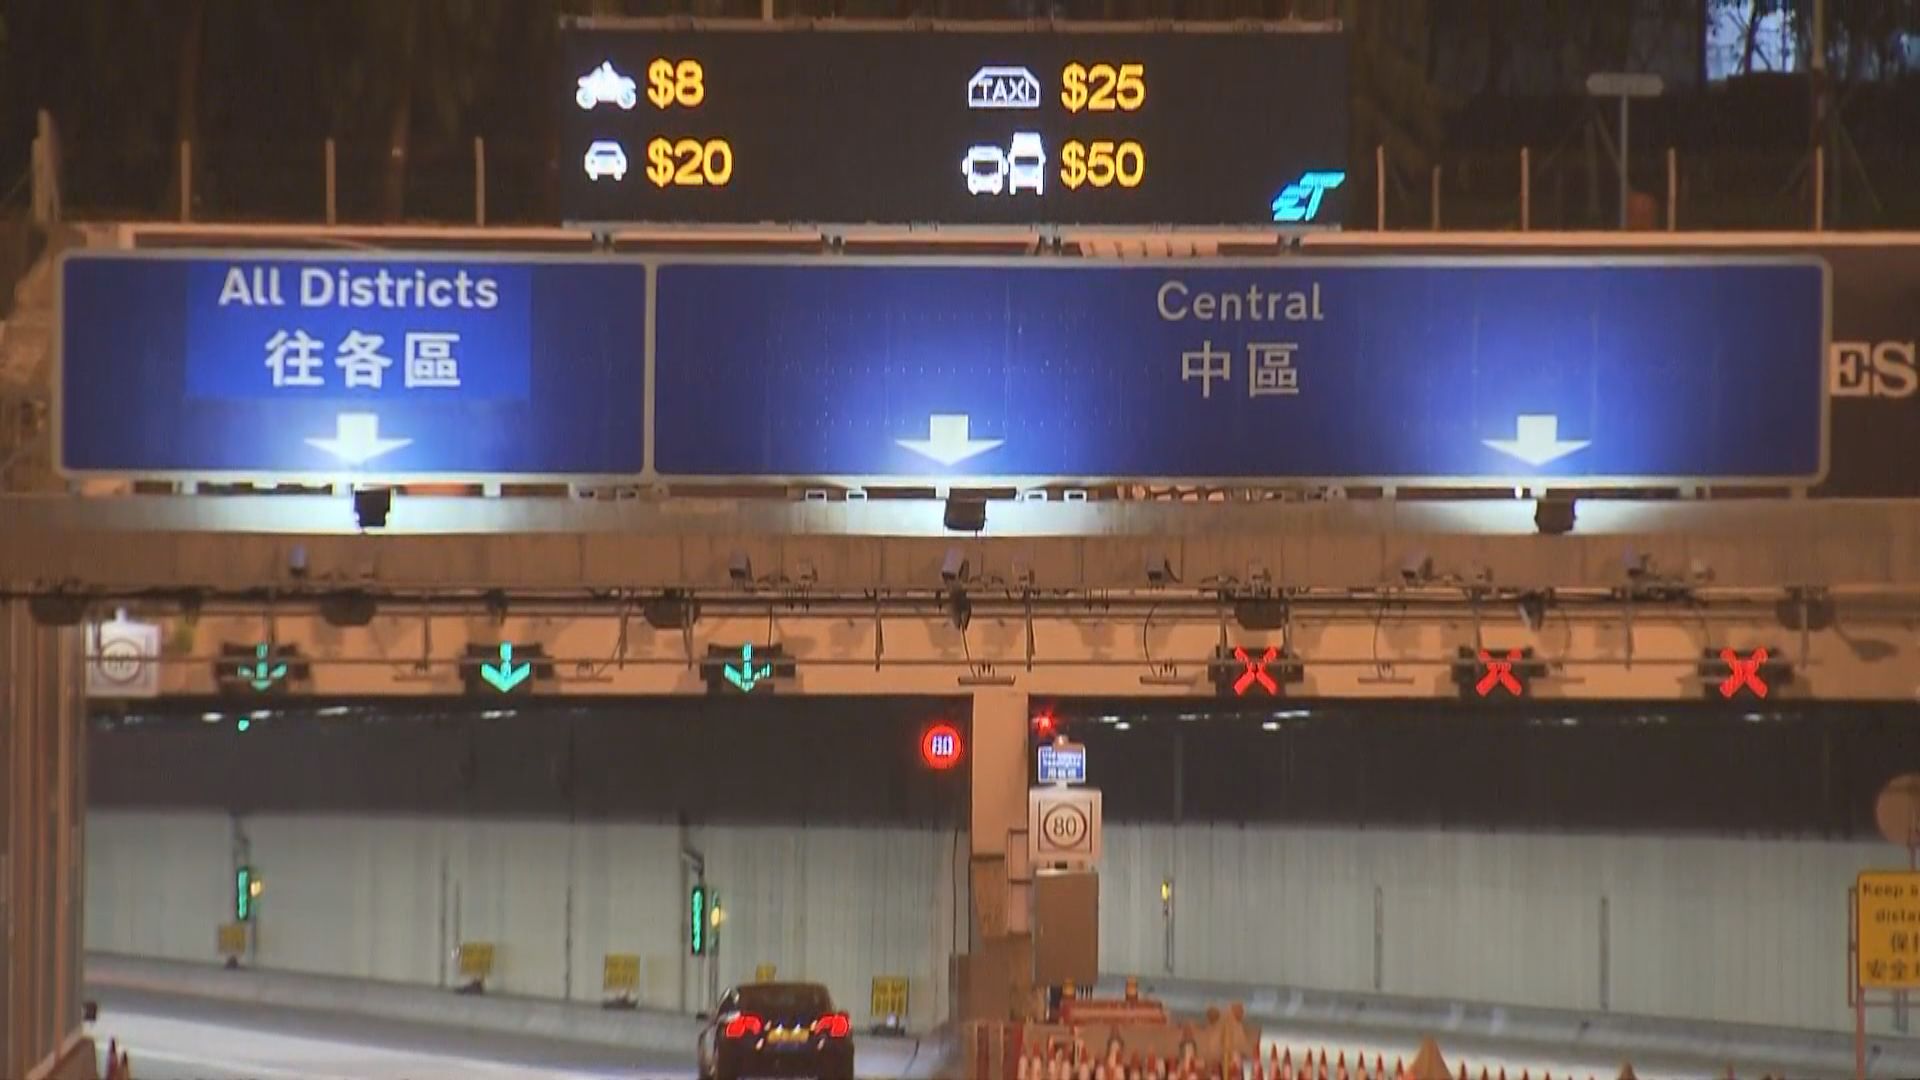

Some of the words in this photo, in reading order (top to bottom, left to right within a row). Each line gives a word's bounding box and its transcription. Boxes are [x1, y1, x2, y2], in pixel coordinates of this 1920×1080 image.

[647, 58, 705, 109] $8
[978, 77, 1031, 103] TAXI
[1061, 62, 1145, 113] $25
[646, 138, 732, 187] $20
[1060, 140, 1144, 190] $50
[218, 268, 285, 306] All
[300, 268, 499, 309] Districts
[1157, 281, 1324, 321] Central
[265, 330, 461, 388] 往各區
[1182, 340, 1299, 398] 中區
[1053, 815, 1077, 837] 80
